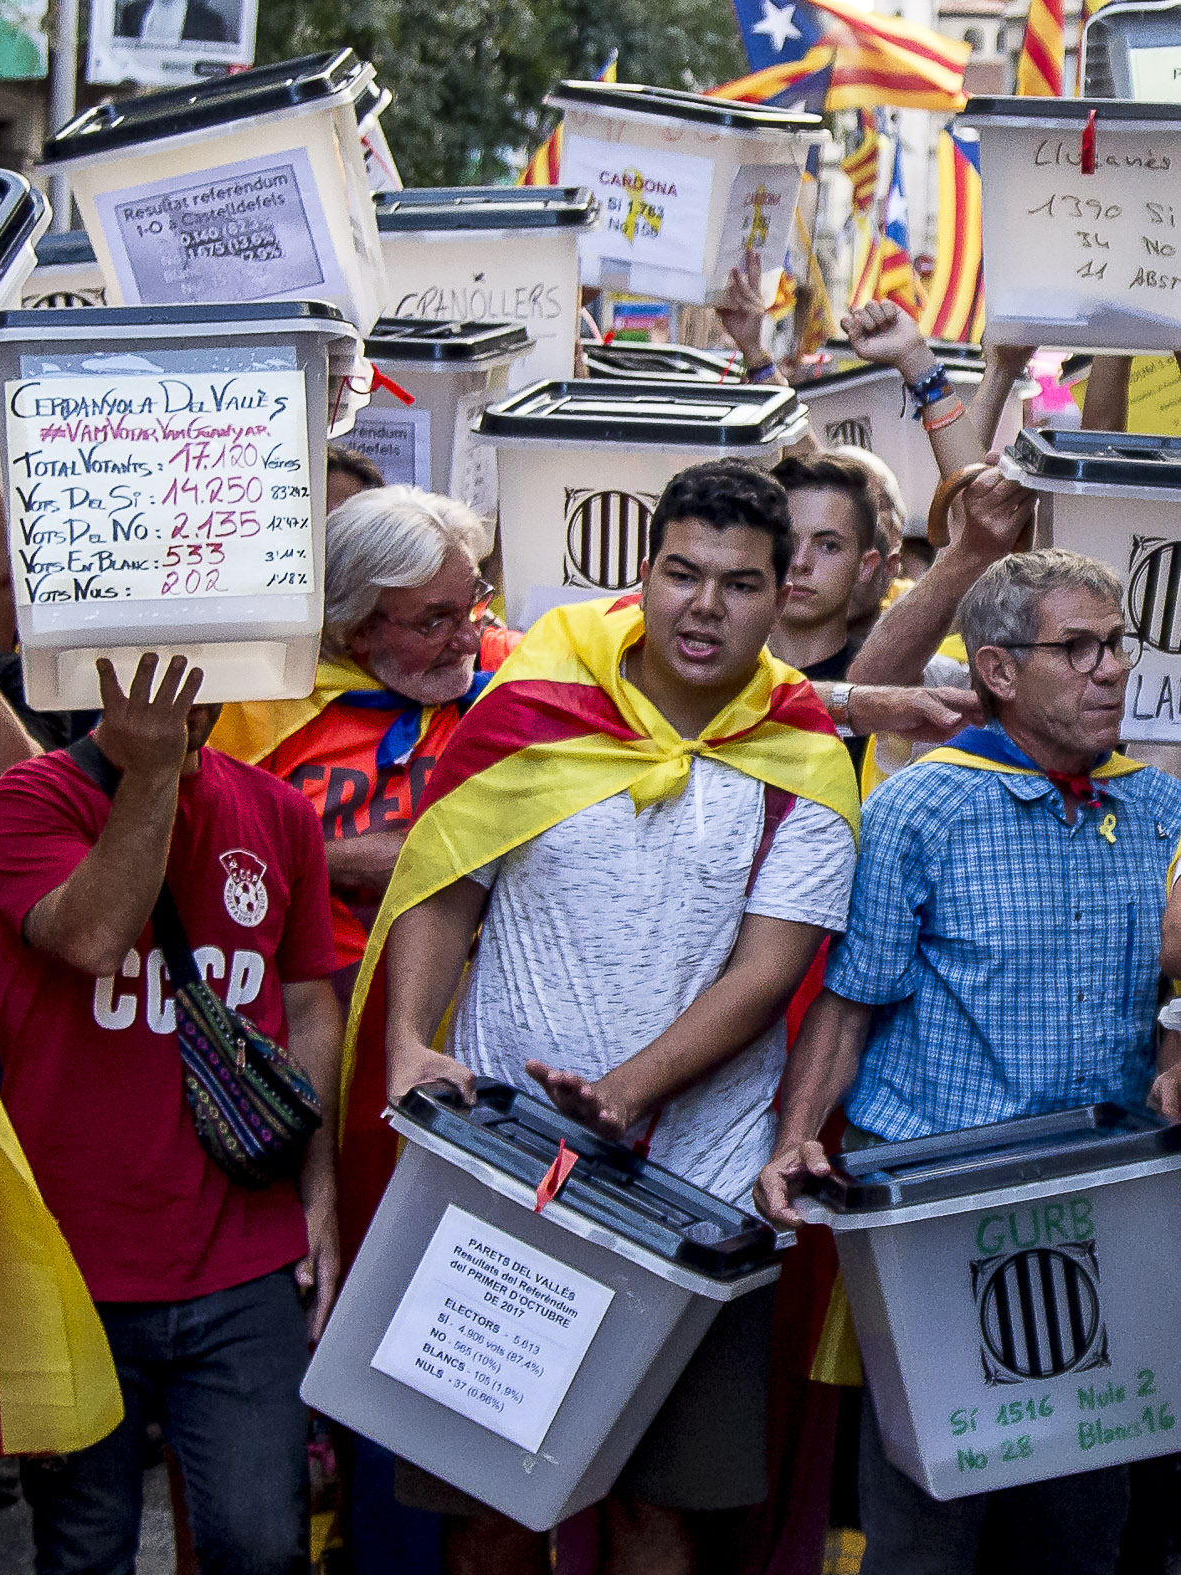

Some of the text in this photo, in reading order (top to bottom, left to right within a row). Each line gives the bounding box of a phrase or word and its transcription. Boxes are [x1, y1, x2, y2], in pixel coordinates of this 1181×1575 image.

[124, 174, 288, 222] Resultat referendum
[599, 170, 678, 197] CARDONA
[1027, 194, 1122, 219] 1390
[169, 441, 258, 472] 17.120
[162, 477, 263, 505] 14.250
[171, 511, 261, 539] 2.135
[162, 543, 226, 567] 533
[161, 569, 228, 596] 202
[1133, 673, 1181, 721] LA
[975, 1199, 1096, 1253] GURB
[452, 1245, 500, 1277] Resultats
[500, 1270, 518, 1285] del
[467, 1237, 511, 1267] PARETS
[511, 1261, 533, 1279] DEL
[449, 1258, 571, 1329] del PRIMER D'OCTUBRE
[483, 1292, 524, 1319] DE 2017
[444, 1297, 501, 1334] ELECTORS
[422, 1342, 466, 1372] BLANCS
[429, 1328, 446, 1342] NO
[471, 1350, 502, 1374] (10%)
[485, 1339, 506, 1356] vots
[414, 1357, 444, 1379] NULS
[453, 1378, 466, 1391] 37
[1137, 1368, 1156, 1398] 2
[995, 1393, 1055, 1427] 1516
[1141, 1401, 1175, 1434] 16
[956, 1448, 988, 1472] No
